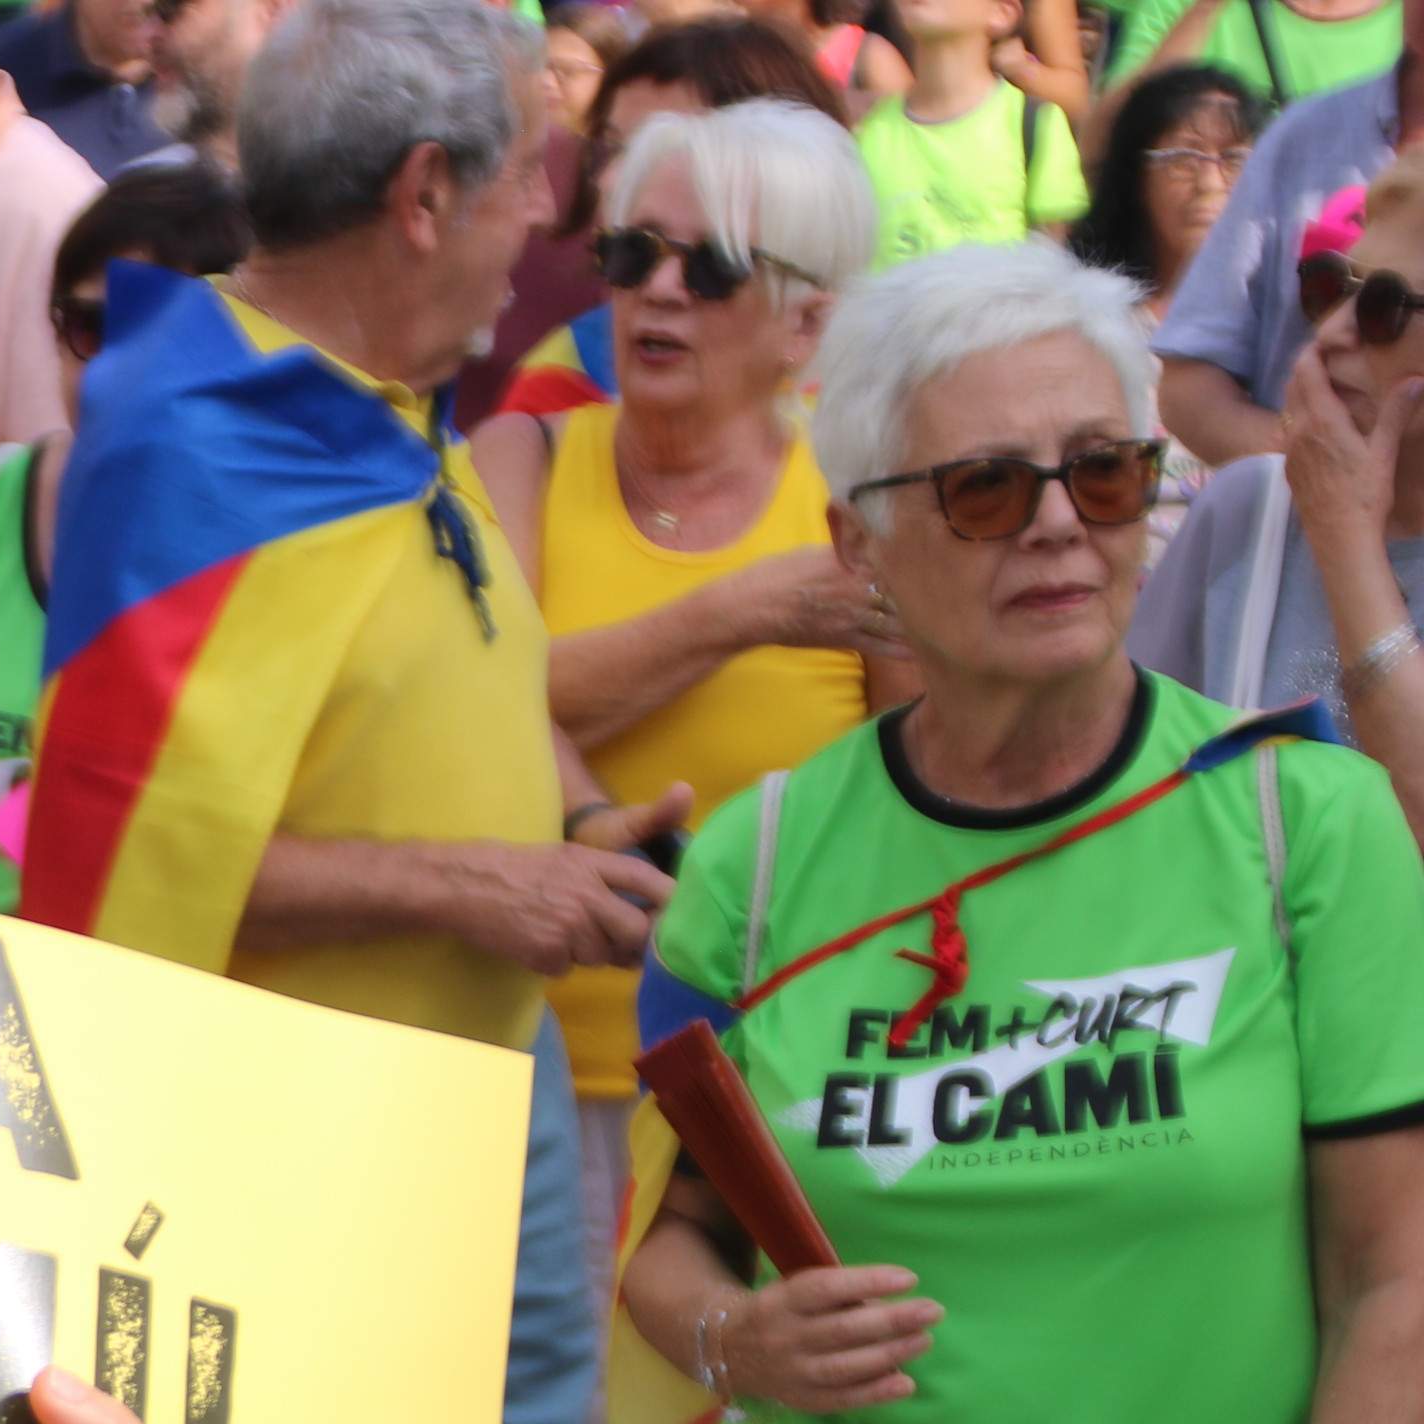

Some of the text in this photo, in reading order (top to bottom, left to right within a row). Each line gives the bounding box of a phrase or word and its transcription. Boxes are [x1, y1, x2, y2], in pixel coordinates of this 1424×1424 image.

[817, 1043, 1188, 1150] EL CAMÍ
[929, 1127, 1195, 1171] INDEPENDÈNCIA
